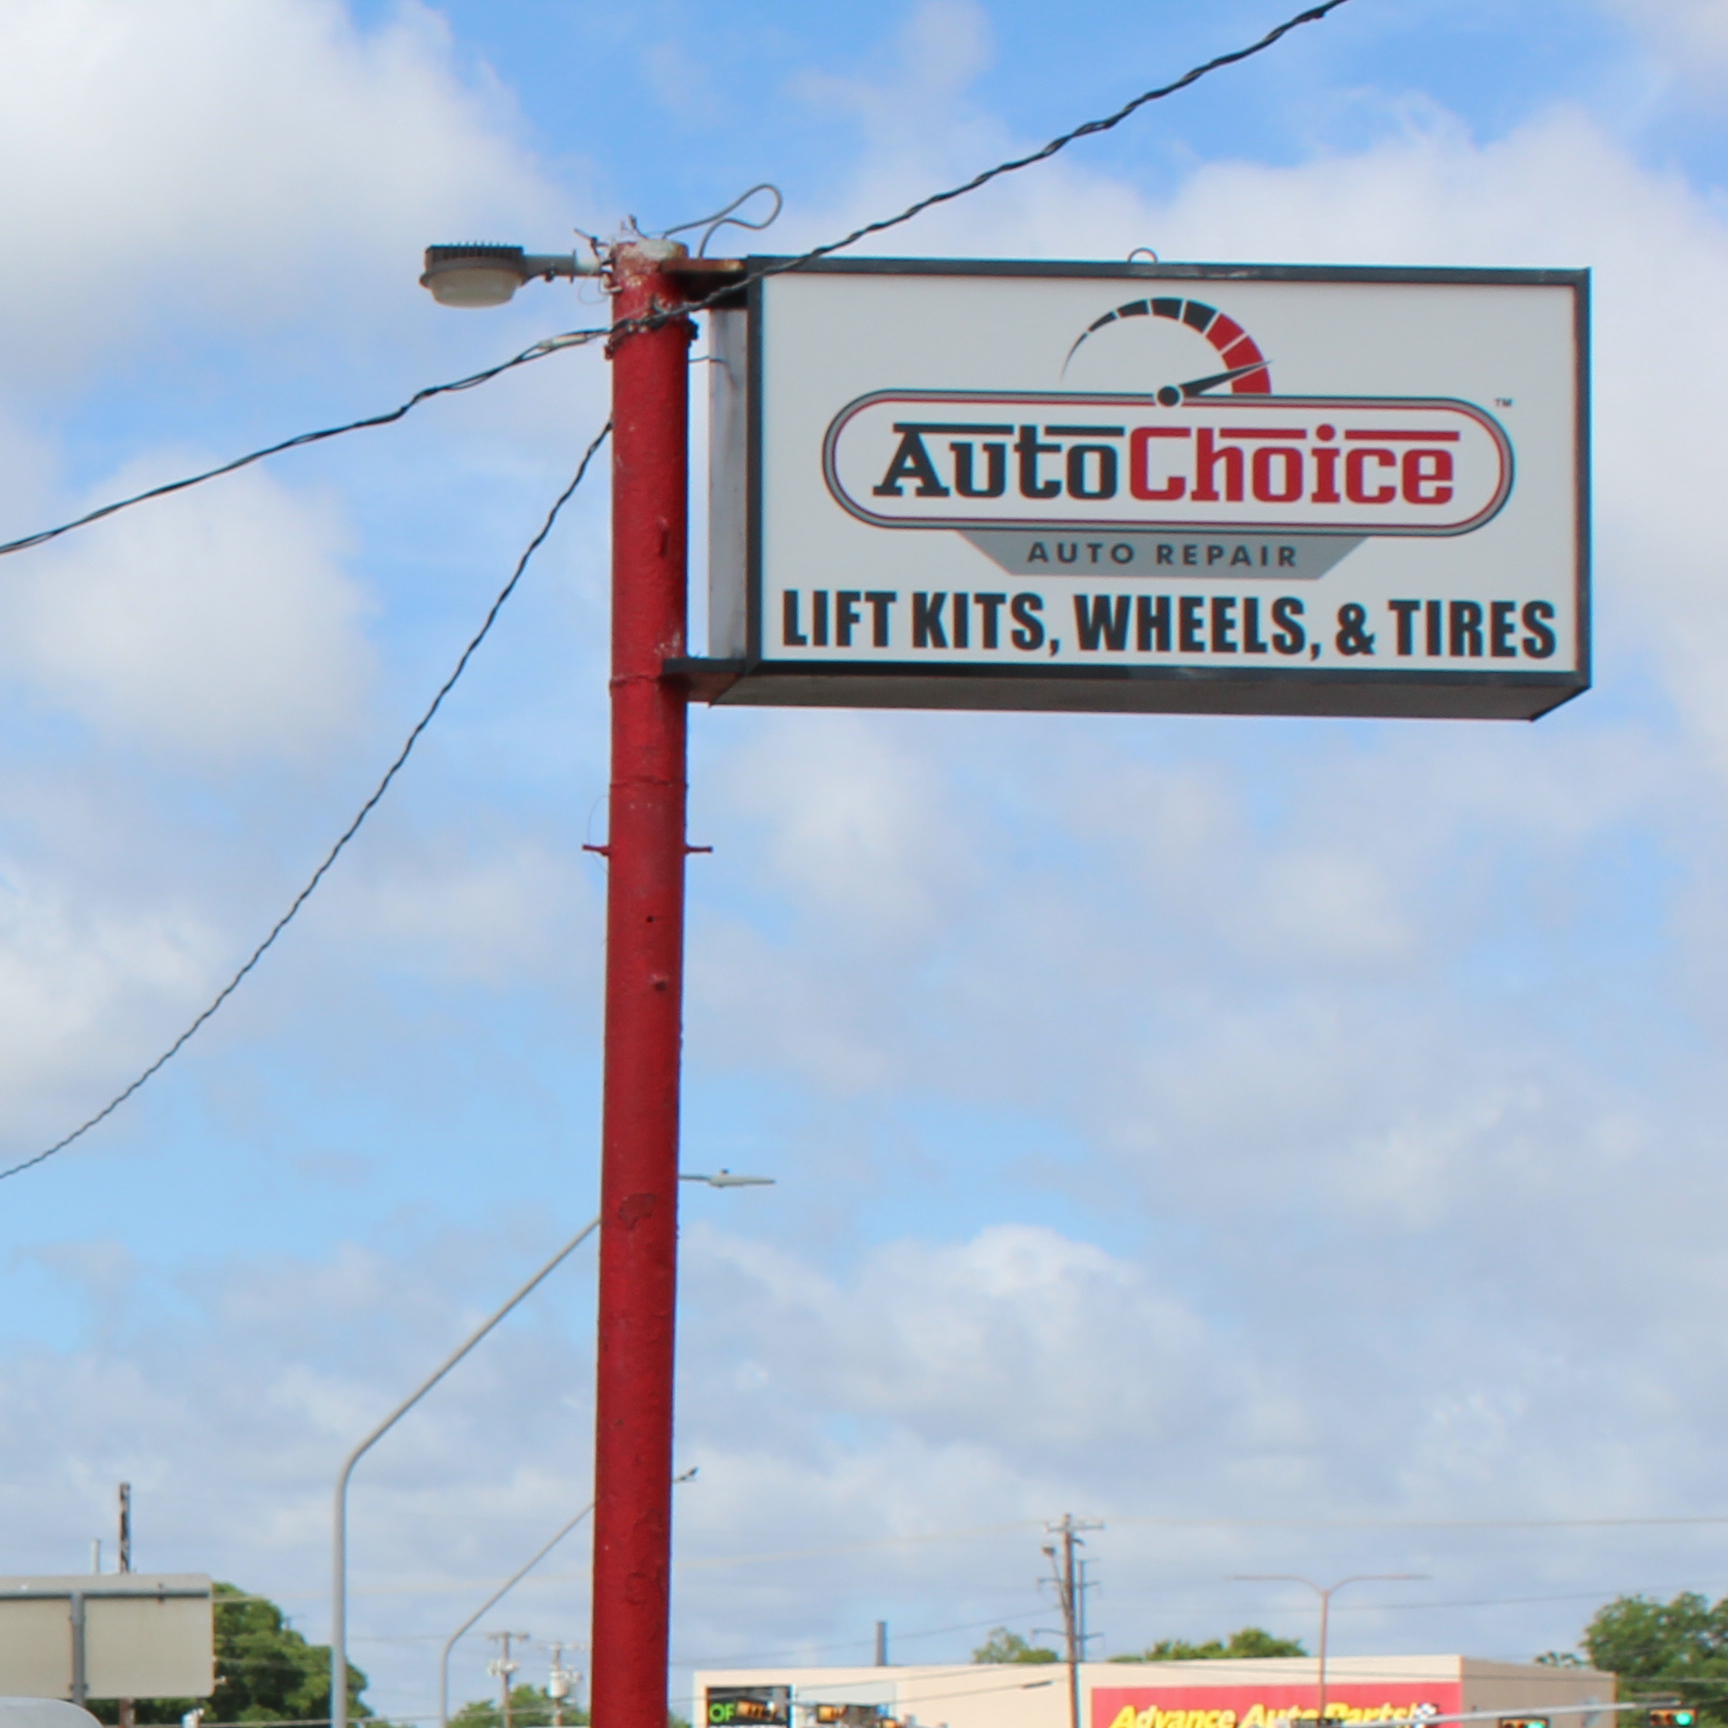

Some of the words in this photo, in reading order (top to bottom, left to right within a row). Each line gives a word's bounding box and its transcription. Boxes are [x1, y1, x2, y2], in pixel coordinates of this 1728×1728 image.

[872, 421, 1461, 506] AutoChoice
[1027, 541, 1135, 565] AUTO
[1156, 543, 1297, 567] REPAIR
[781, 589, 898, 649] LIFT
[910, 591, 1061, 658] KITS,
[1074, 594, 1322, 662] WHEELS,
[1334, 601, 1376, 657] &
[1388, 599, 1558, 661] TIRES
